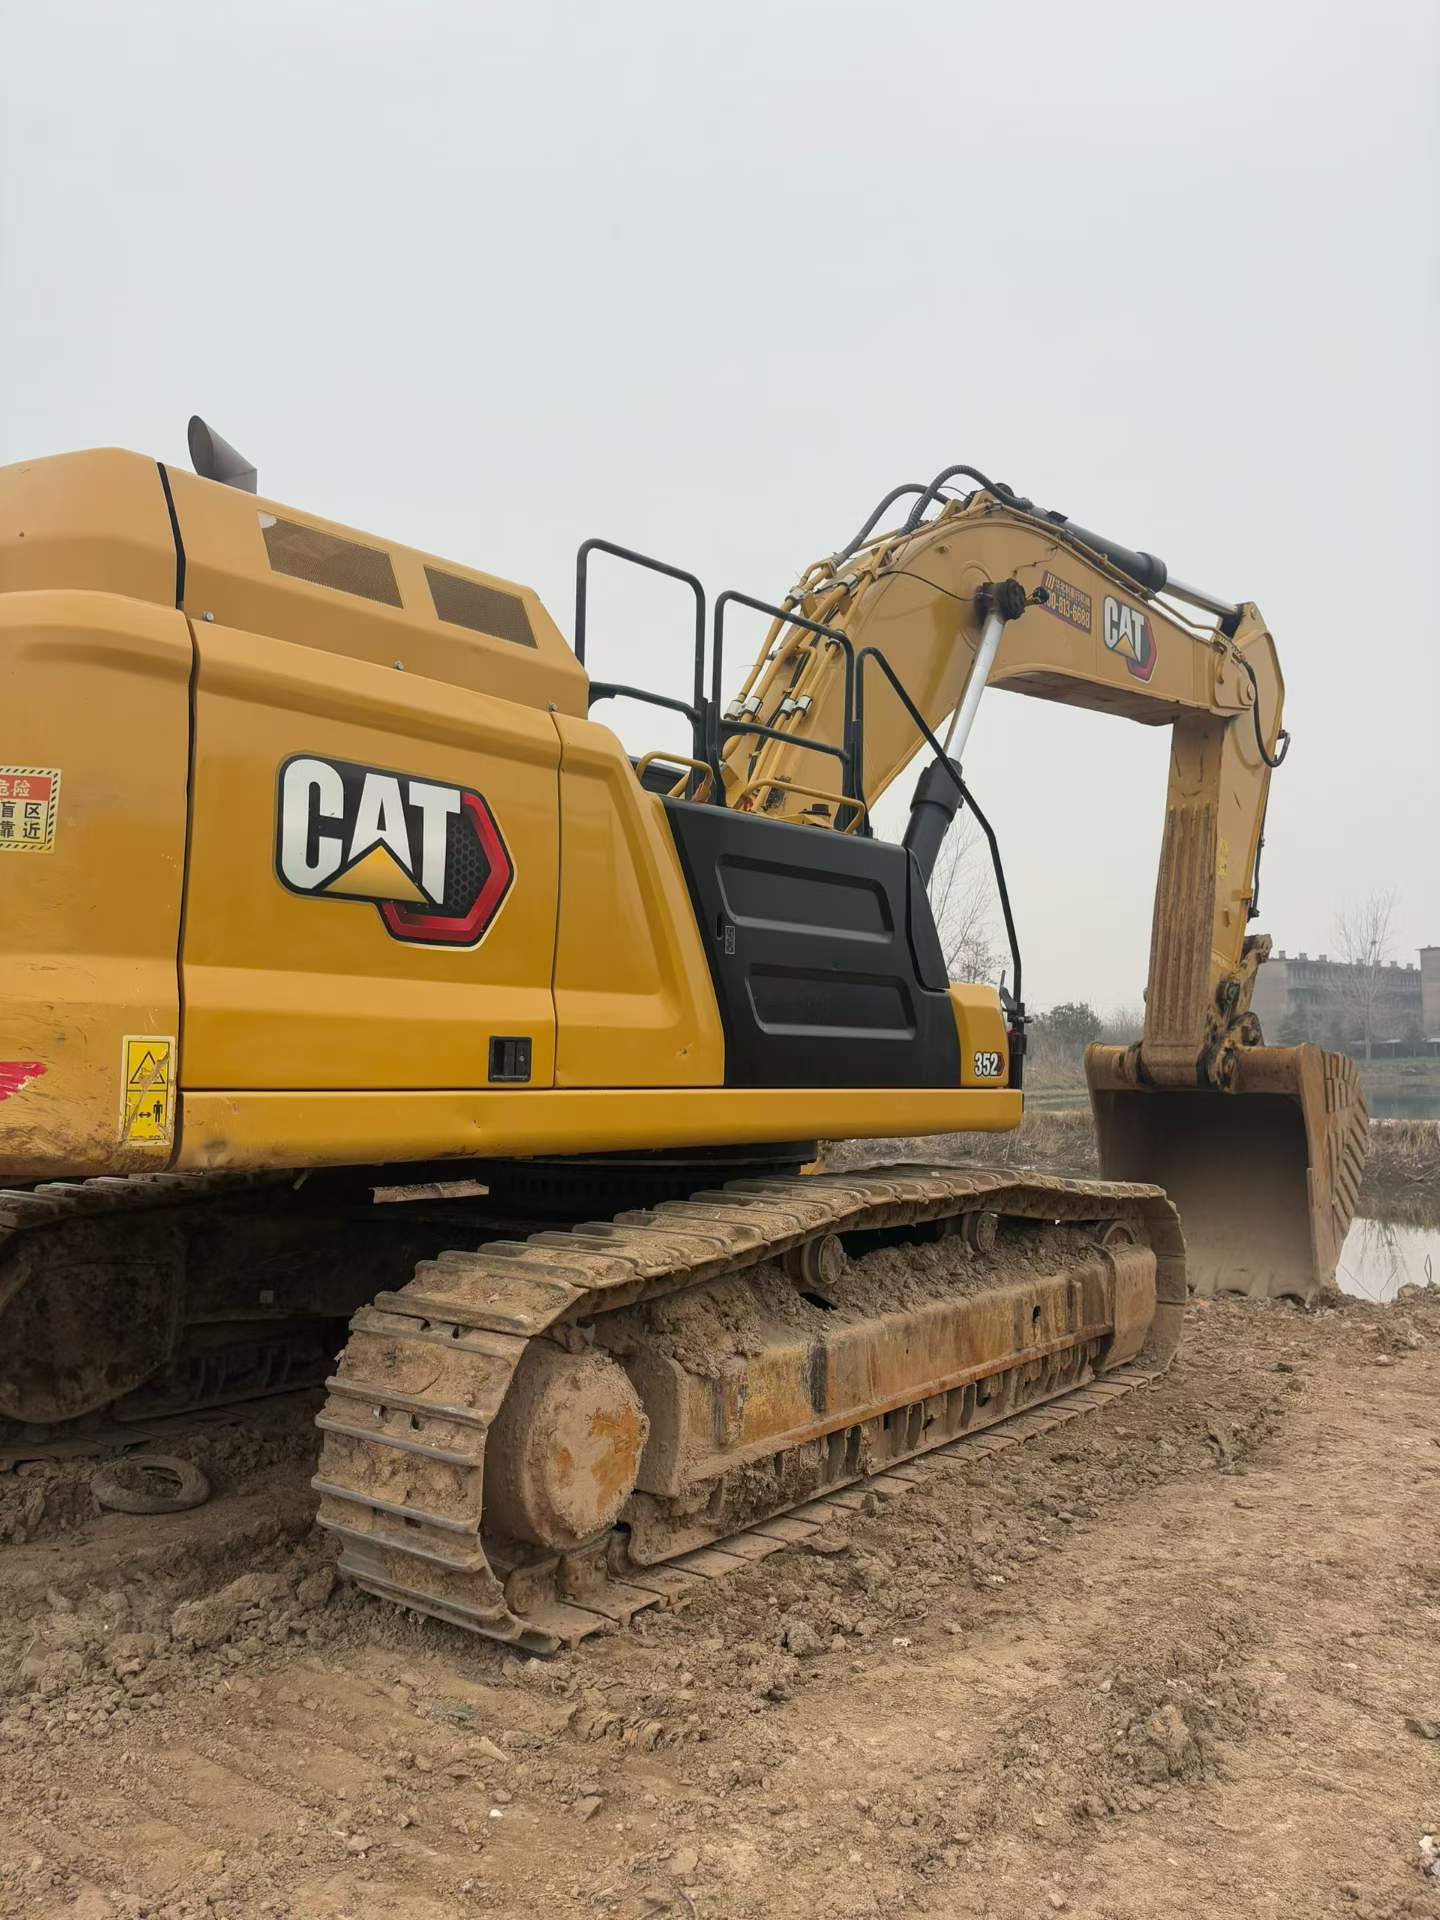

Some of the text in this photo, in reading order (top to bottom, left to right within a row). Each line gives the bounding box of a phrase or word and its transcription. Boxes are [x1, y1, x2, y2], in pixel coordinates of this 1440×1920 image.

[1046, 589, 1090, 628] 00-813-6688
[1104, 596, 1145, 662] CAT
[281, 758, 461, 905] CAT
[974, 1052, 999, 1076] 352
